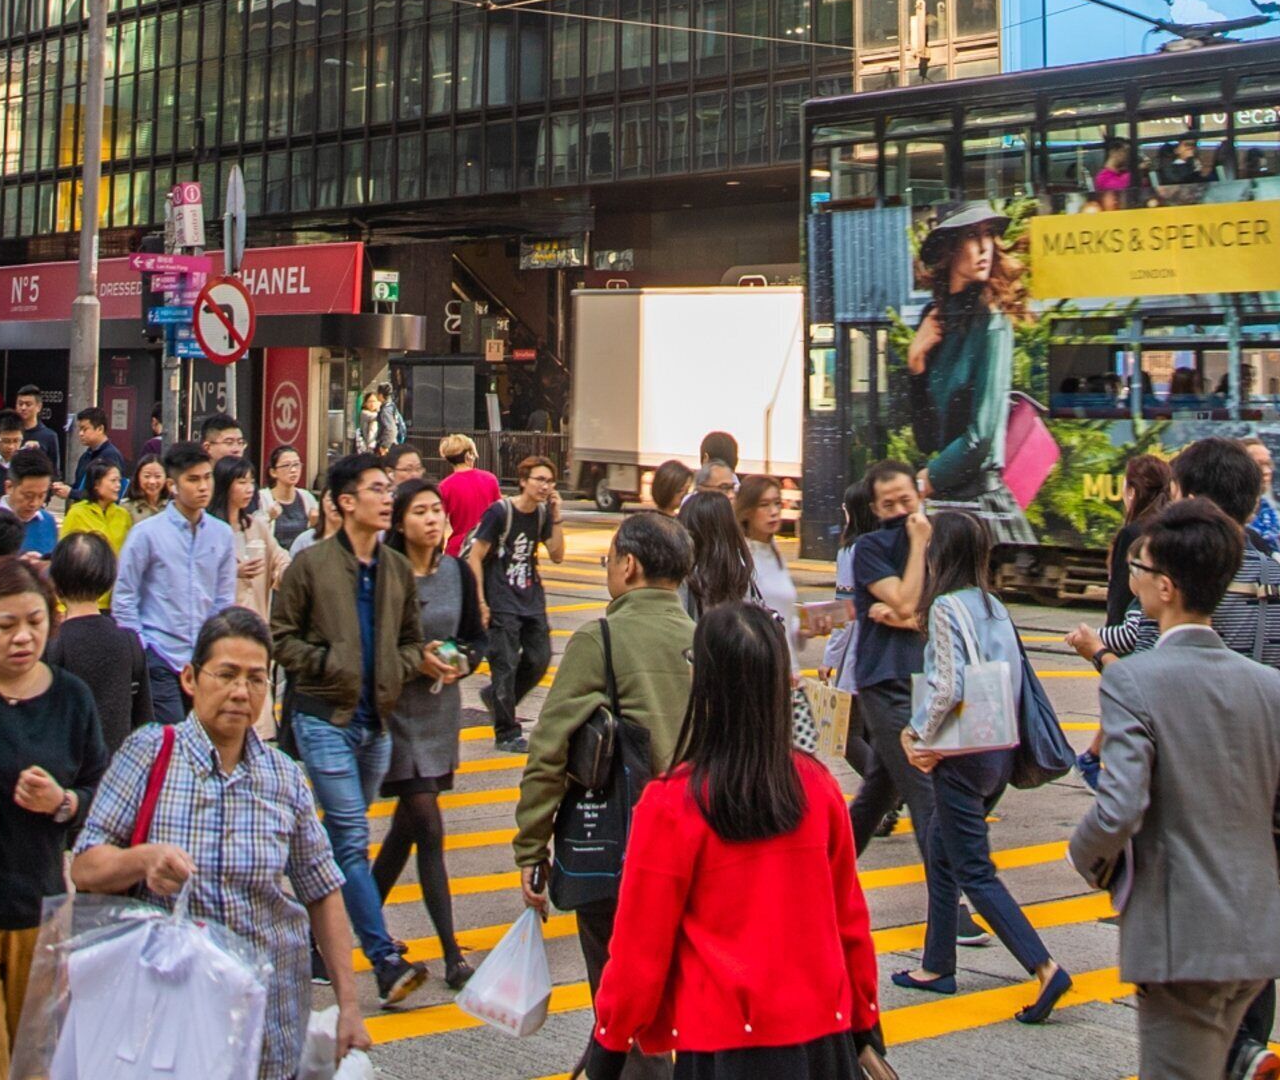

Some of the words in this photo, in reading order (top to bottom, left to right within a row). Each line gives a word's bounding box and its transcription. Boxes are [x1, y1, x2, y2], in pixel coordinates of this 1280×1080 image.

[1042, 227, 1124, 256] MARKS
[1128, 228, 1145, 252] &
[1149, 219, 1272, 251] SPENCER
[100, 281, 143, 298] DRESSED
[488, 341, 500, 353] FT
